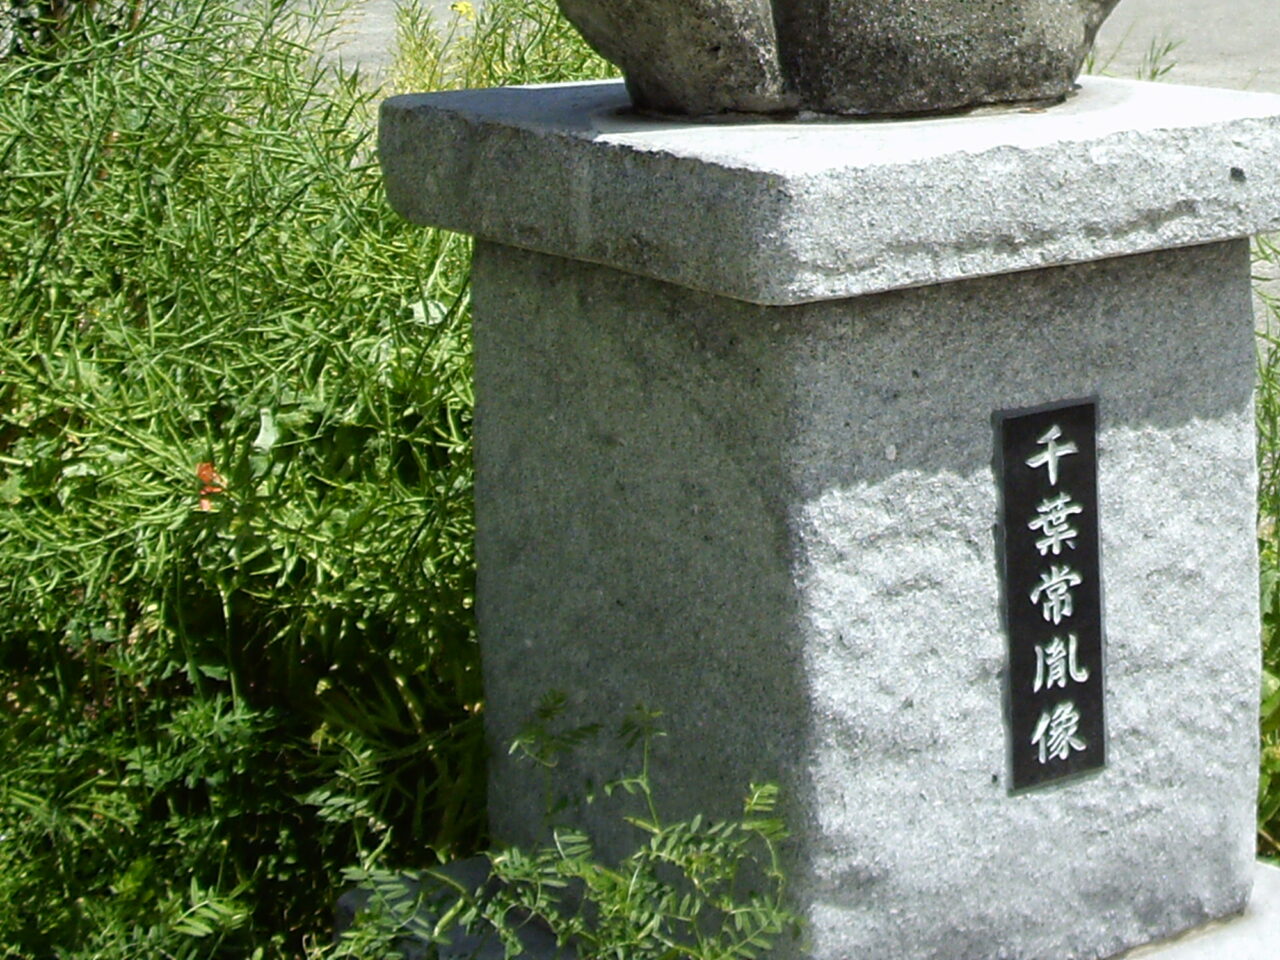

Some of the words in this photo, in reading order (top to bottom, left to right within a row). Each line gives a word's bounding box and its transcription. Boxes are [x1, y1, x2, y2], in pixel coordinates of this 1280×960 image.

[1024, 424, 1090, 765] 千葉常胤像
